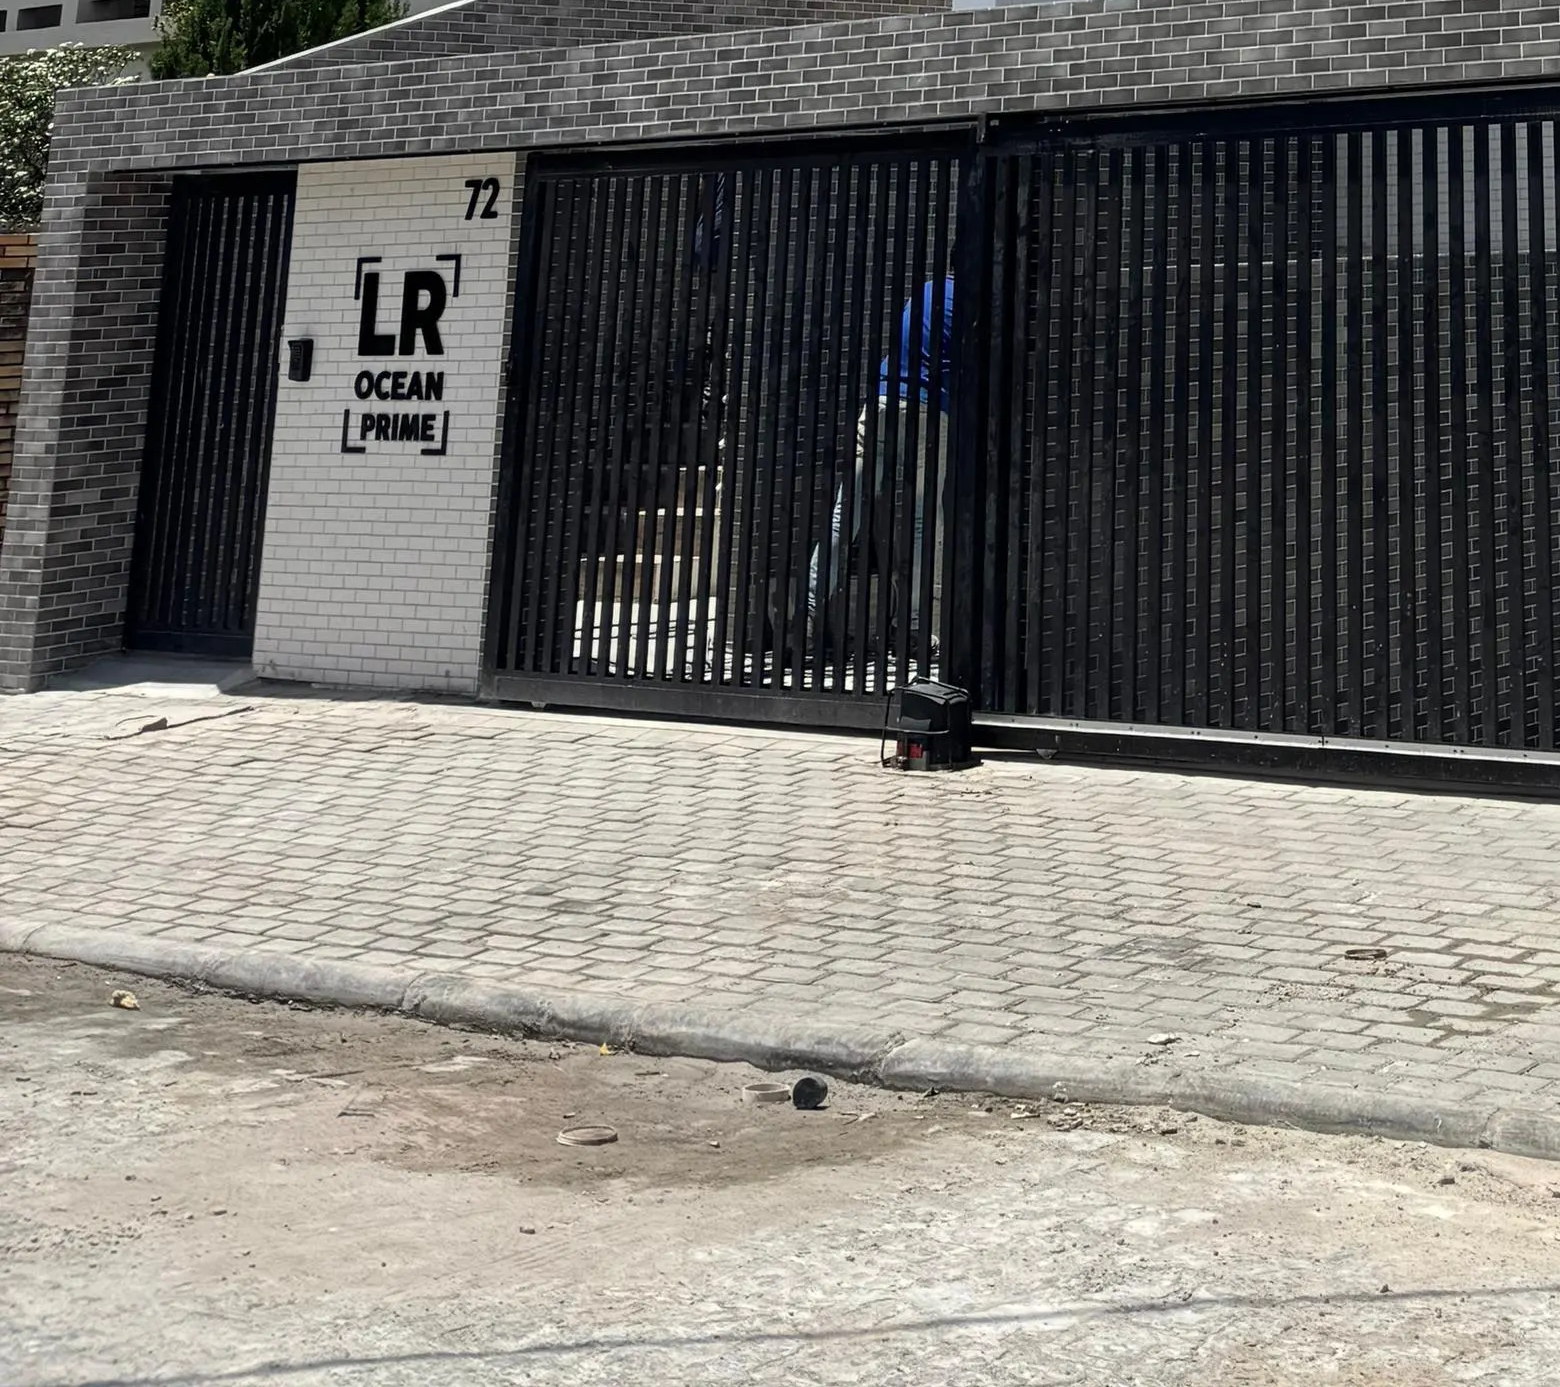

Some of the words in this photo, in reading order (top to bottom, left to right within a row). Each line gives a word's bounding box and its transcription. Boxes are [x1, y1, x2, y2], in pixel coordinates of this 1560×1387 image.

[464, 177, 500, 221] 72
[357, 270, 448, 357] LR
[354, 370, 445, 401] OCEAN
[359, 412, 437, 442] PRIME
